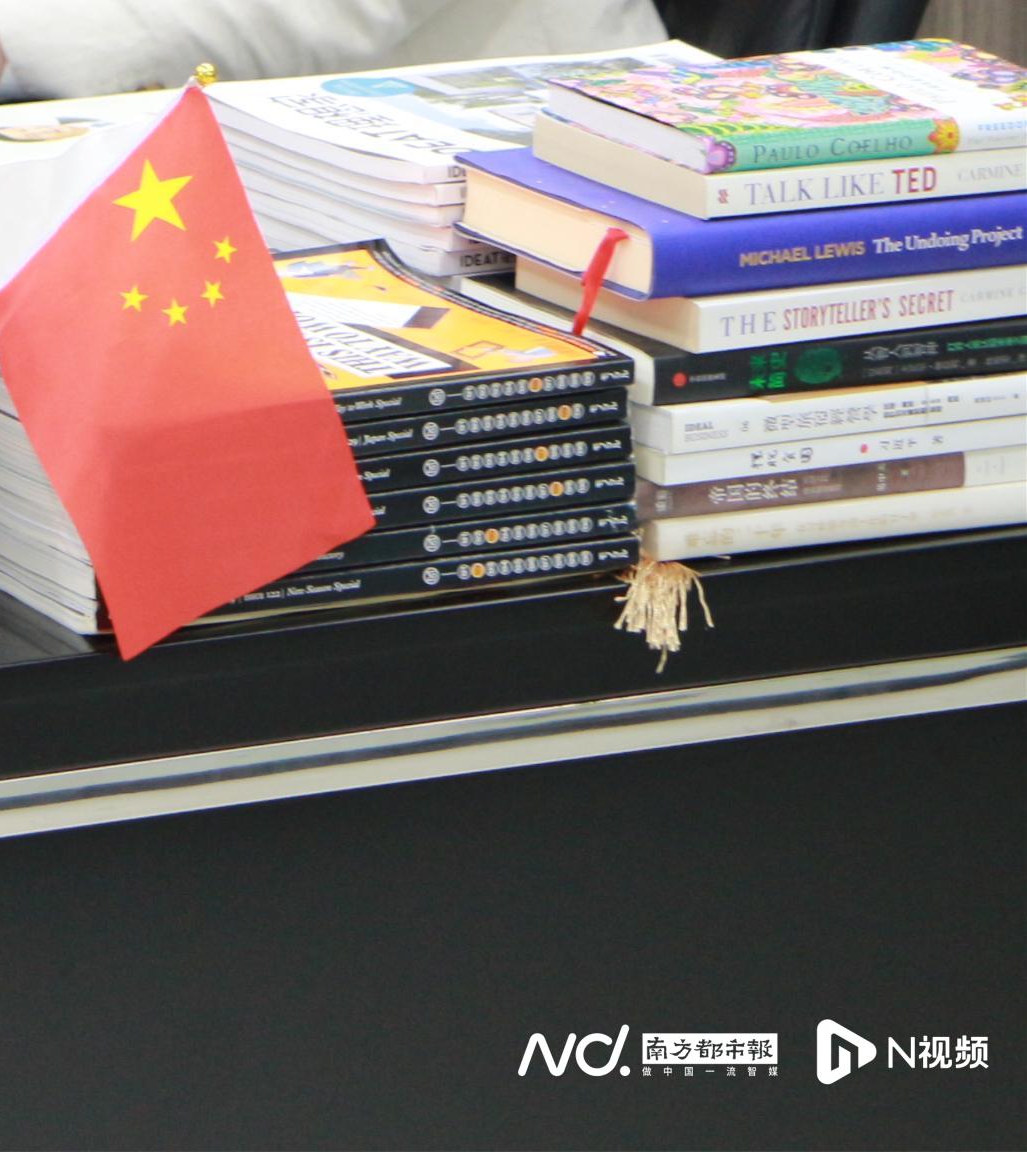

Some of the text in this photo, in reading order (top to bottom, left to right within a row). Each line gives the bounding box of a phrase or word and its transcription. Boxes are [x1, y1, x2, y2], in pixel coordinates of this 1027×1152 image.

[753, 135, 913, 164] PAULO COELHO
[744, 177, 812, 206] TALK
[823, 172, 884, 200] LIKE
[891, 166, 937, 195] TED
[739, 224, 1023, 268] MICHAEL LEWIS The Undoing Project
[720, 310, 777, 337] THE
[783, 297, 891, 331] STORYTELLER'S
[898, 289, 955, 318] SECRET
